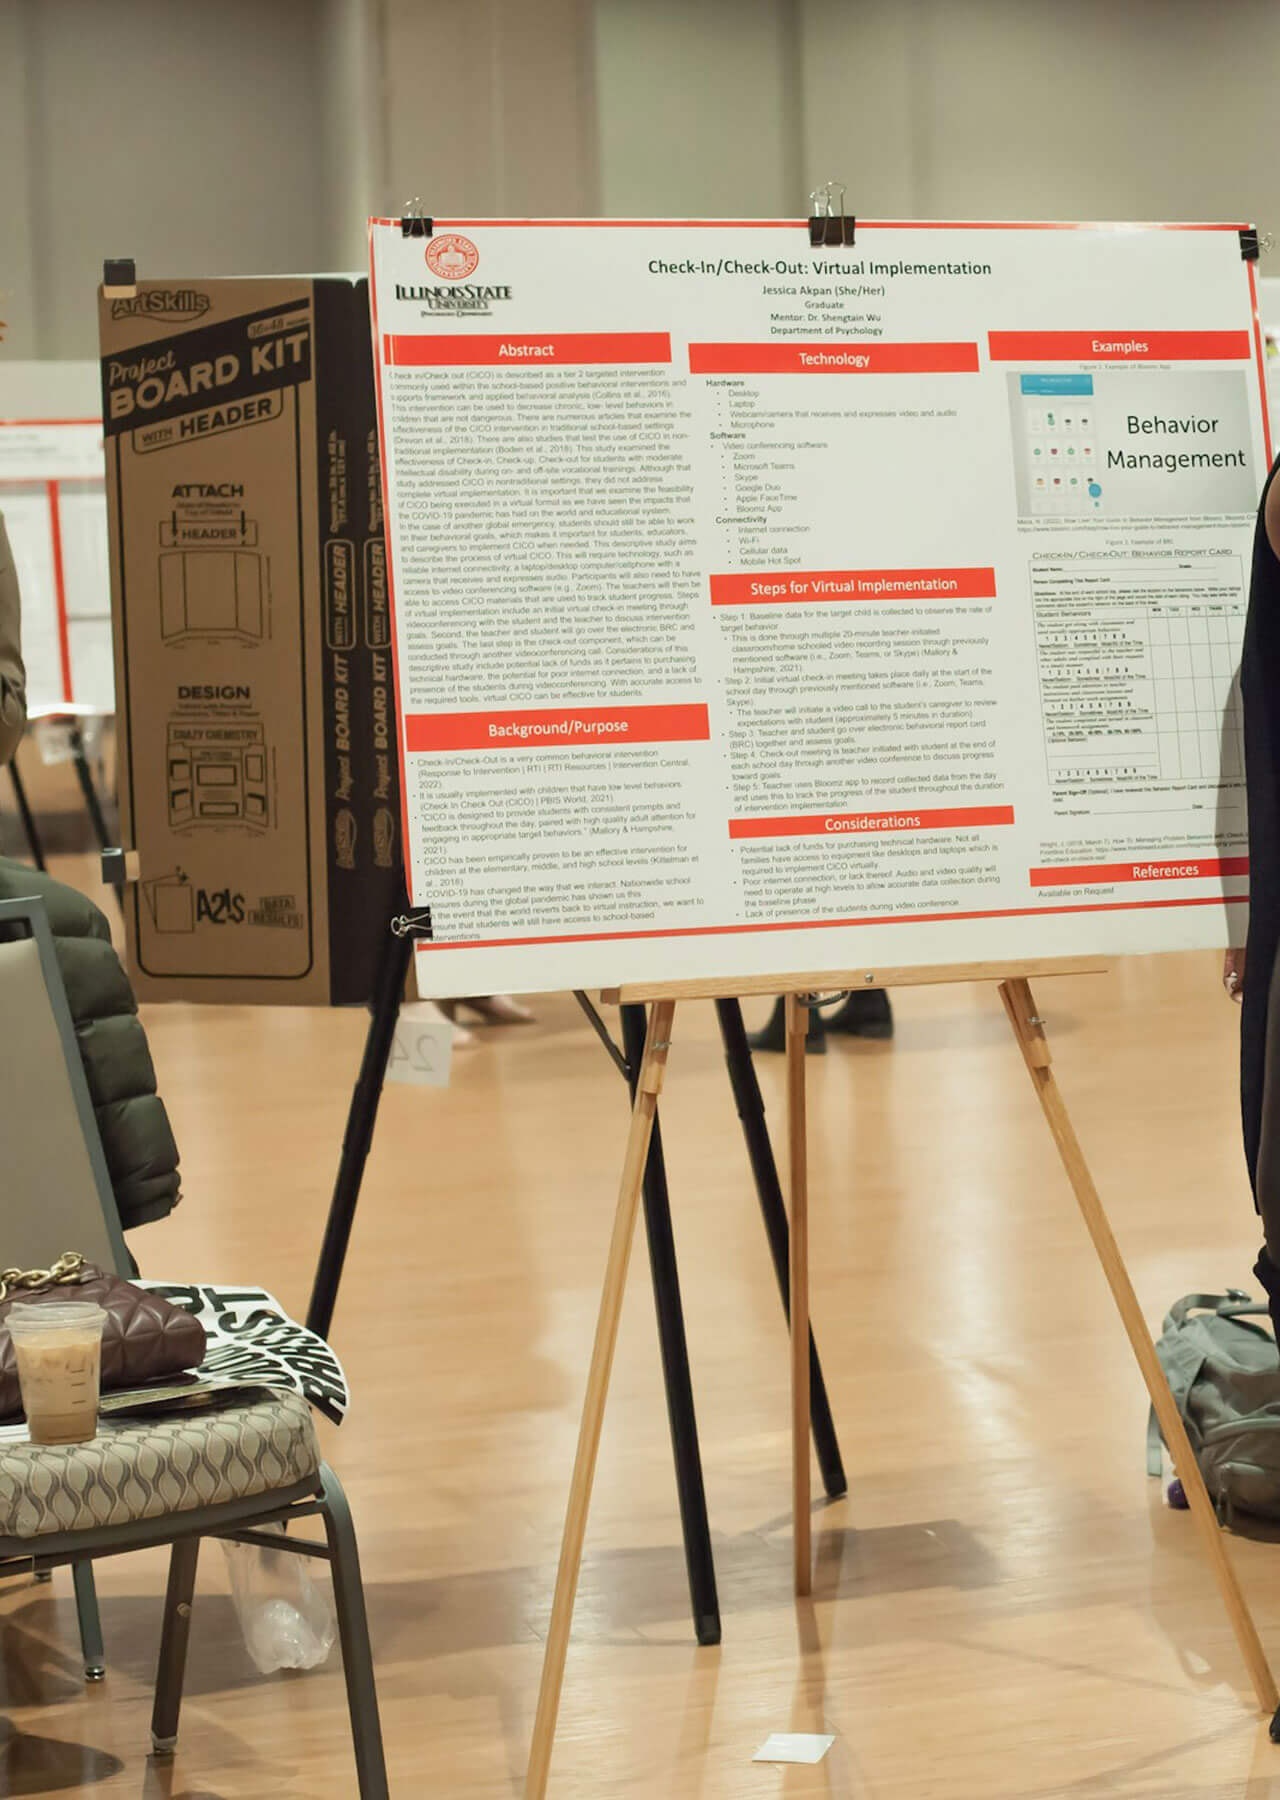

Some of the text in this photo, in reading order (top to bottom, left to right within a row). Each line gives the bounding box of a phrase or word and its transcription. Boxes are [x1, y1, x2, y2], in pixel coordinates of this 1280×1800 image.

[648, 258, 991, 278] Check-In/Check-Out: Virtual Implementation
[762, 285, 885, 297] Jessica Akpan (She/Her)
[112, 290, 210, 315] ArtSkills
[804, 300, 844, 309] Graduate
[770, 313, 805, 321] Mentor:
[807, 313, 818, 321] Dr.
[865, 313, 881, 322] Wu
[770, 326, 883, 336] Department of Psychology
[498, 343, 554, 357] Abstract
[1091, 339, 1149, 354] Examples
[799, 352, 870, 368] Technology
[109, 350, 176, 387] Project
[110, 332, 309, 420] BOARD KIT
[705, 379, 744, 387] Hardware
[727, 388, 760, 398] Desktop
[728, 400, 755, 409] Laptop
[180, 398, 273, 438] HEADER
[794, 410, 809, 418] that
[843, 410, 857, 418] and
[898, 409, 919, 417] video
[935, 408, 957, 416] audio
[730, 420, 775, 429] Microphone
[1127, 415, 1219, 434] Behavior
[709, 431, 746, 440] Software
[721, 441, 828, 450] Video conferencing software
[732, 451, 755, 460] Zoom
[1107, 449, 1246, 473] Management
[733, 461, 795, 471] Microsoft Teams
[734, 472, 758, 482] Skype
[171, 483, 244, 498] ATTACH
[734, 482, 781, 493] Google Duo
[735, 493, 797, 504] Apple FaceTime
[766, 503, 783, 512] App
[715, 515, 767, 524] Connectivity
[181, 528, 236, 539] HEADER
[737, 525, 810, 534] Internet connection
[737, 536, 760, 544] Wi-Fi
[738, 546, 788, 555] Cellular data
[739, 555, 801, 566] Mobile Hot Spot
[333, 544, 347, 613] HEADER
[372, 544, 385, 613] HEADER
[750, 578, 957, 596] Steps for Virtual Implementation
[334, 655, 349, 682] KIT
[372, 655, 387, 682] KIT
[178, 685, 250, 700] DESIGN
[334, 686, 349, 752] BOARD
[373, 685, 388, 749] BOARD
[488, 719, 628, 738] Background/Purpose
[516, 755, 533, 764] very
[535, 753, 570, 762] common
[571, 751, 612, 760] behavioral
[613, 749, 658, 758] intervention
[824, 814, 922, 832] Considerations
[1132, 864, 1198, 879] References
[1036, 885, 1071, 897] Available
[1083, 885, 1114, 896] Request
